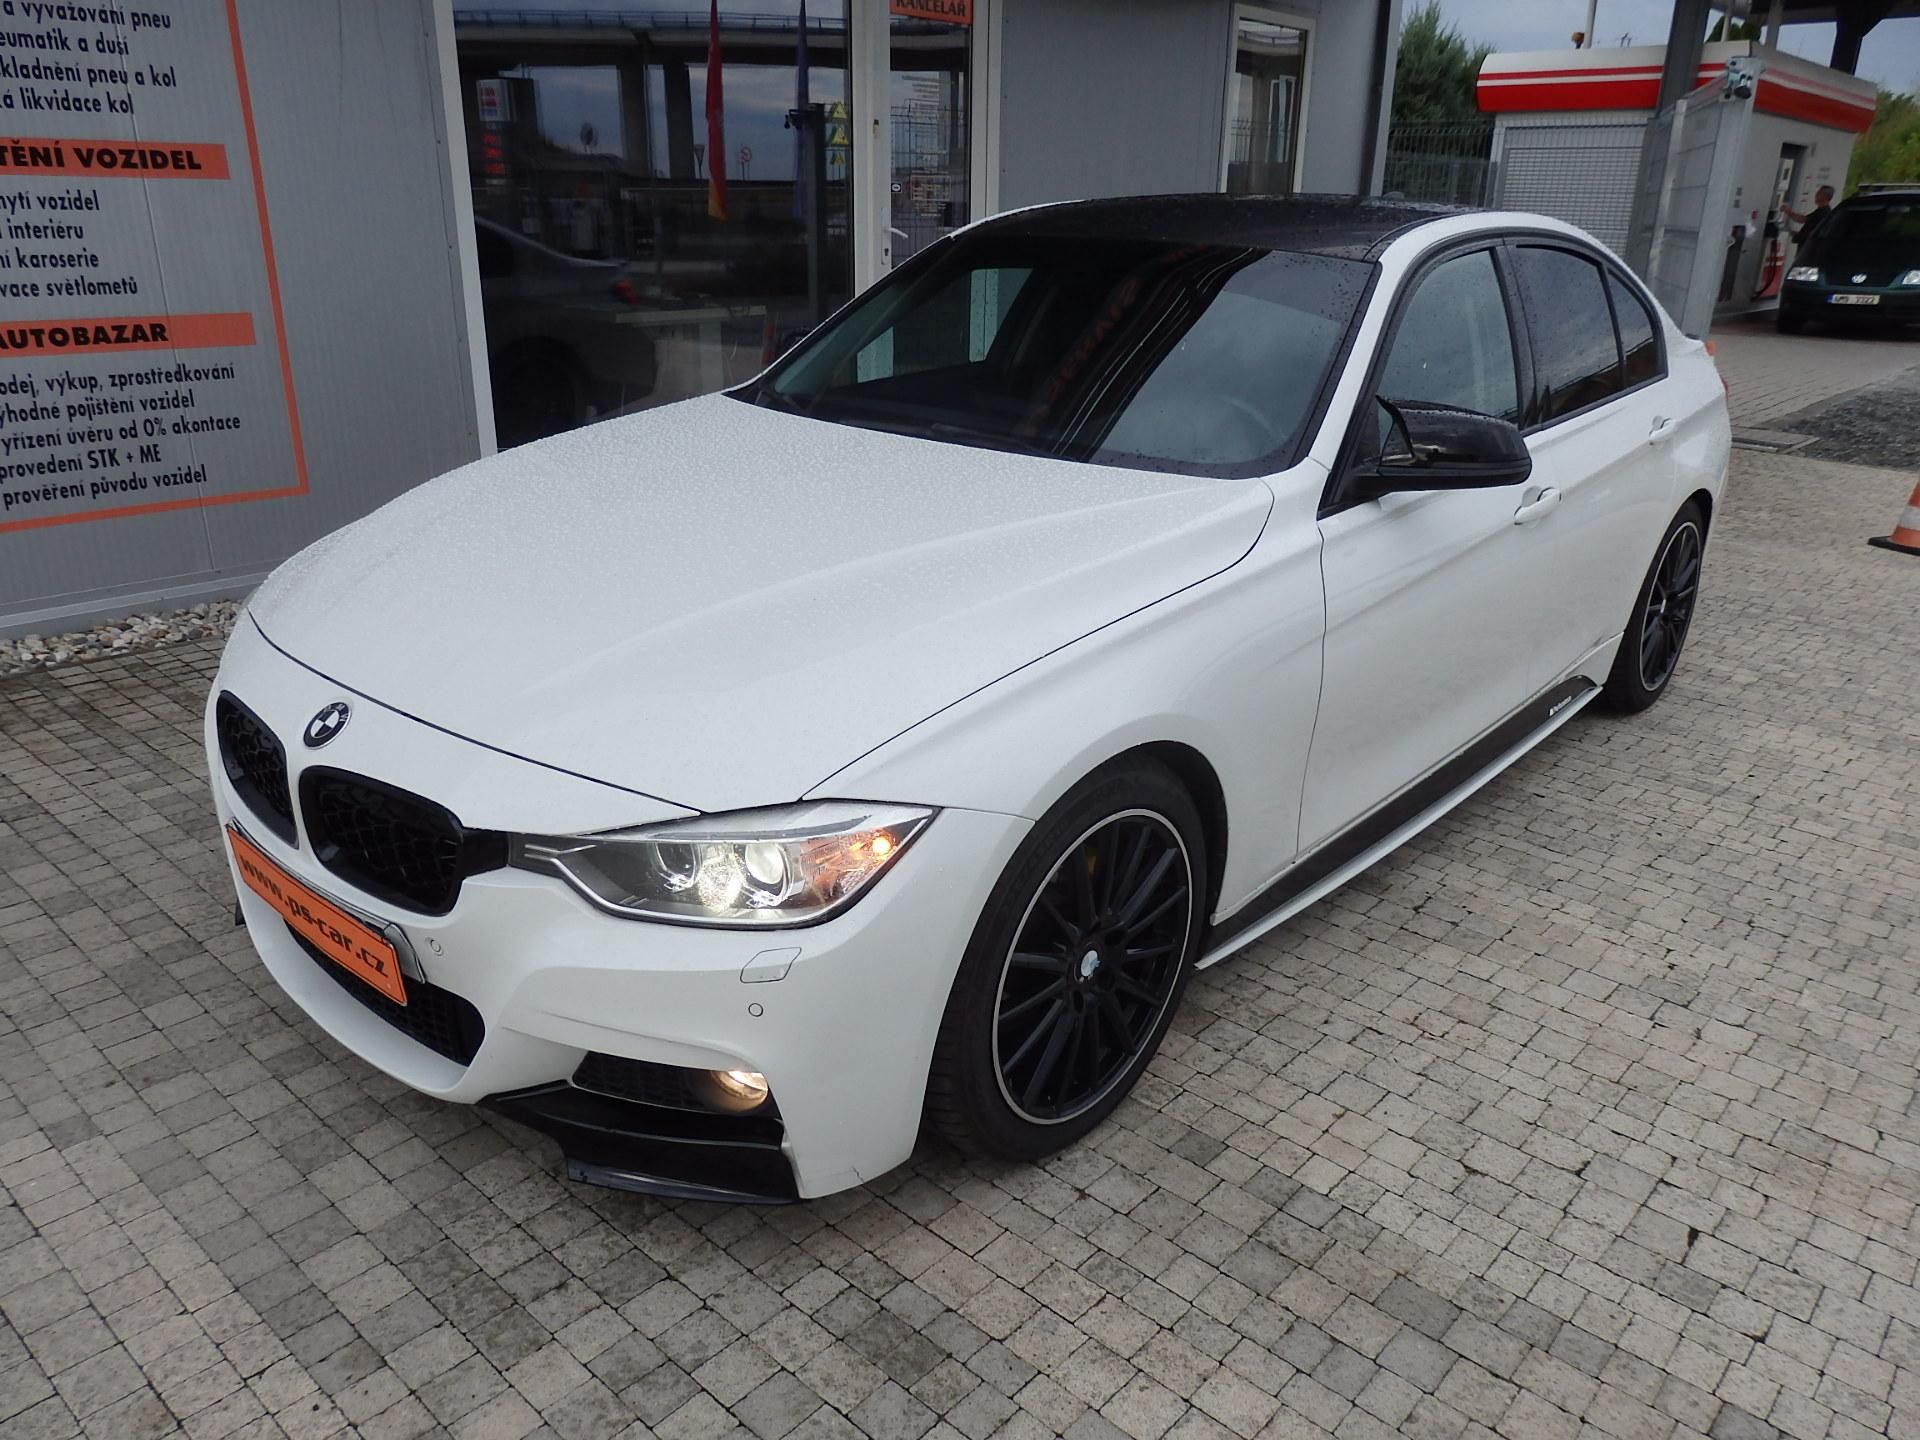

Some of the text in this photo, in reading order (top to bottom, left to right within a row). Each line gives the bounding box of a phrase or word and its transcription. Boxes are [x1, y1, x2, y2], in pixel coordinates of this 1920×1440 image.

[3, 1, 172, 31] a vyvažování pneu
[78, 37, 89, 52] a
[96, 32, 129, 55] duší
[0, 55, 177, 87] kladnění pneu a kol
[0, 87, 135, 114] á likvidace kol
[73, 147, 202, 170] VOZIDEL
[37, 189, 100, 211] vozidel
[7, 219, 84, 239] interiéru
[16, 247, 99, 268] karoserie
[47, 275, 138, 297] světlometů
[45, 371, 103, 397] výkup,
[108, 362, 235, 388] zprostředkování
[67, 397, 136, 422] pojištění
[139, 389, 195, 412] vozidel
[1, 415, 240, 456] yřízení úvěru od 0% akontace
[0, 453, 83, 484] provedení
[88, 448, 121, 469] STK
[139, 444, 162, 464] ME
[3, 464, 207, 510] prověření původu vozidel
[240, 855, 390, 978] www.ps-car.cz
